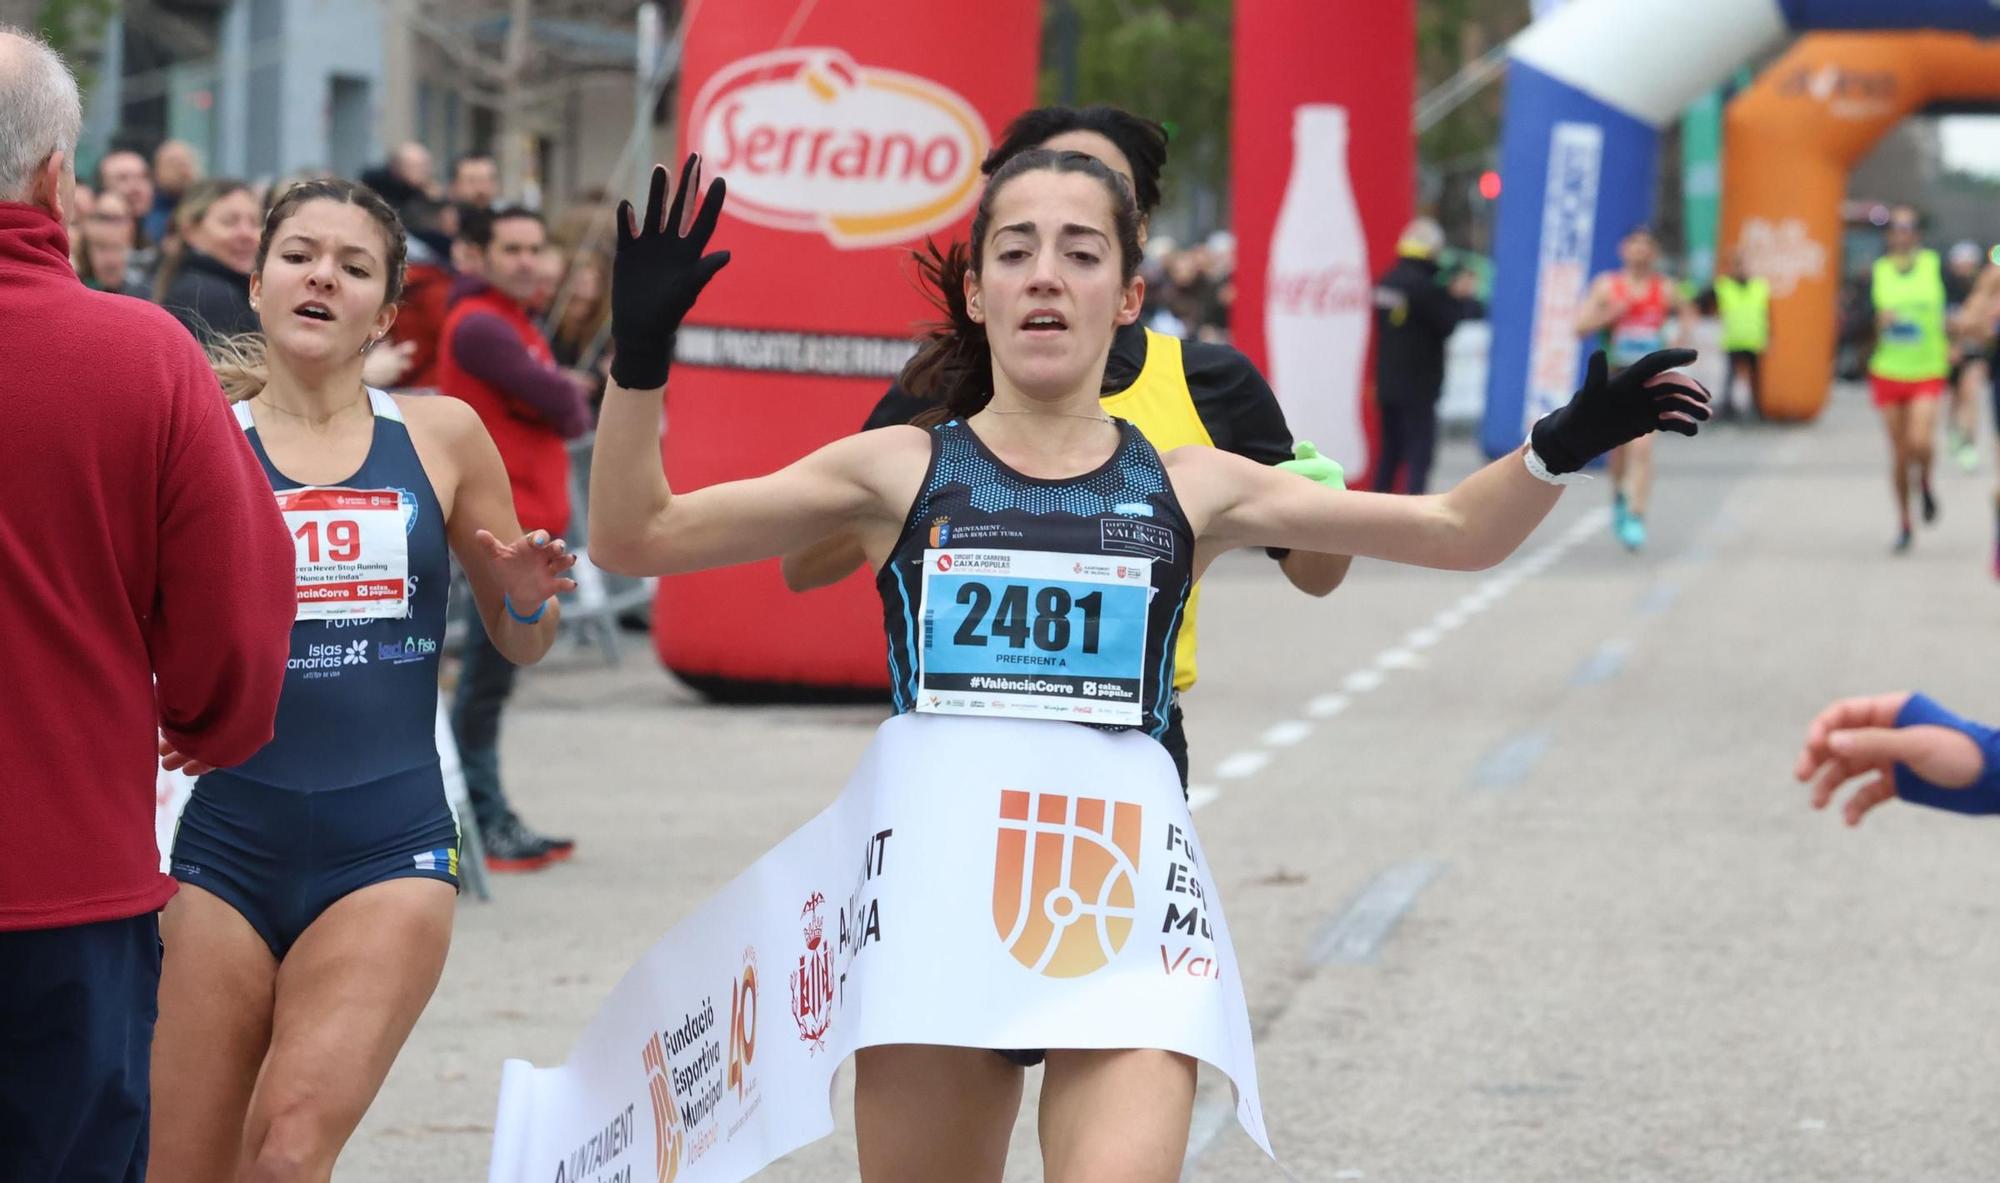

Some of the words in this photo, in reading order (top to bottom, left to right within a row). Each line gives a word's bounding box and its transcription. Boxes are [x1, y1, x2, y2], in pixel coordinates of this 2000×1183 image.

[716, 103, 961, 185] Serrano
[294, 520, 361, 562] 19
[357, 563, 388, 571] Running
[297, 588, 350, 598] nciaCorre
[953, 582, 1103, 654] 2481
[308, 643, 343, 656] Islas
[287, 655, 342, 669] anarias
[996, 654, 1056, 667] PREFERENT
[1059, 658, 1066, 667] A
[970, 677, 1074, 694] #ValènciaCorre
[1098, 689, 1133, 698] popular
[663, 996, 715, 1061] Fundació
[671, 1041, 720, 1098] Esportiva
[680, 1069, 723, 1133] Municipal
